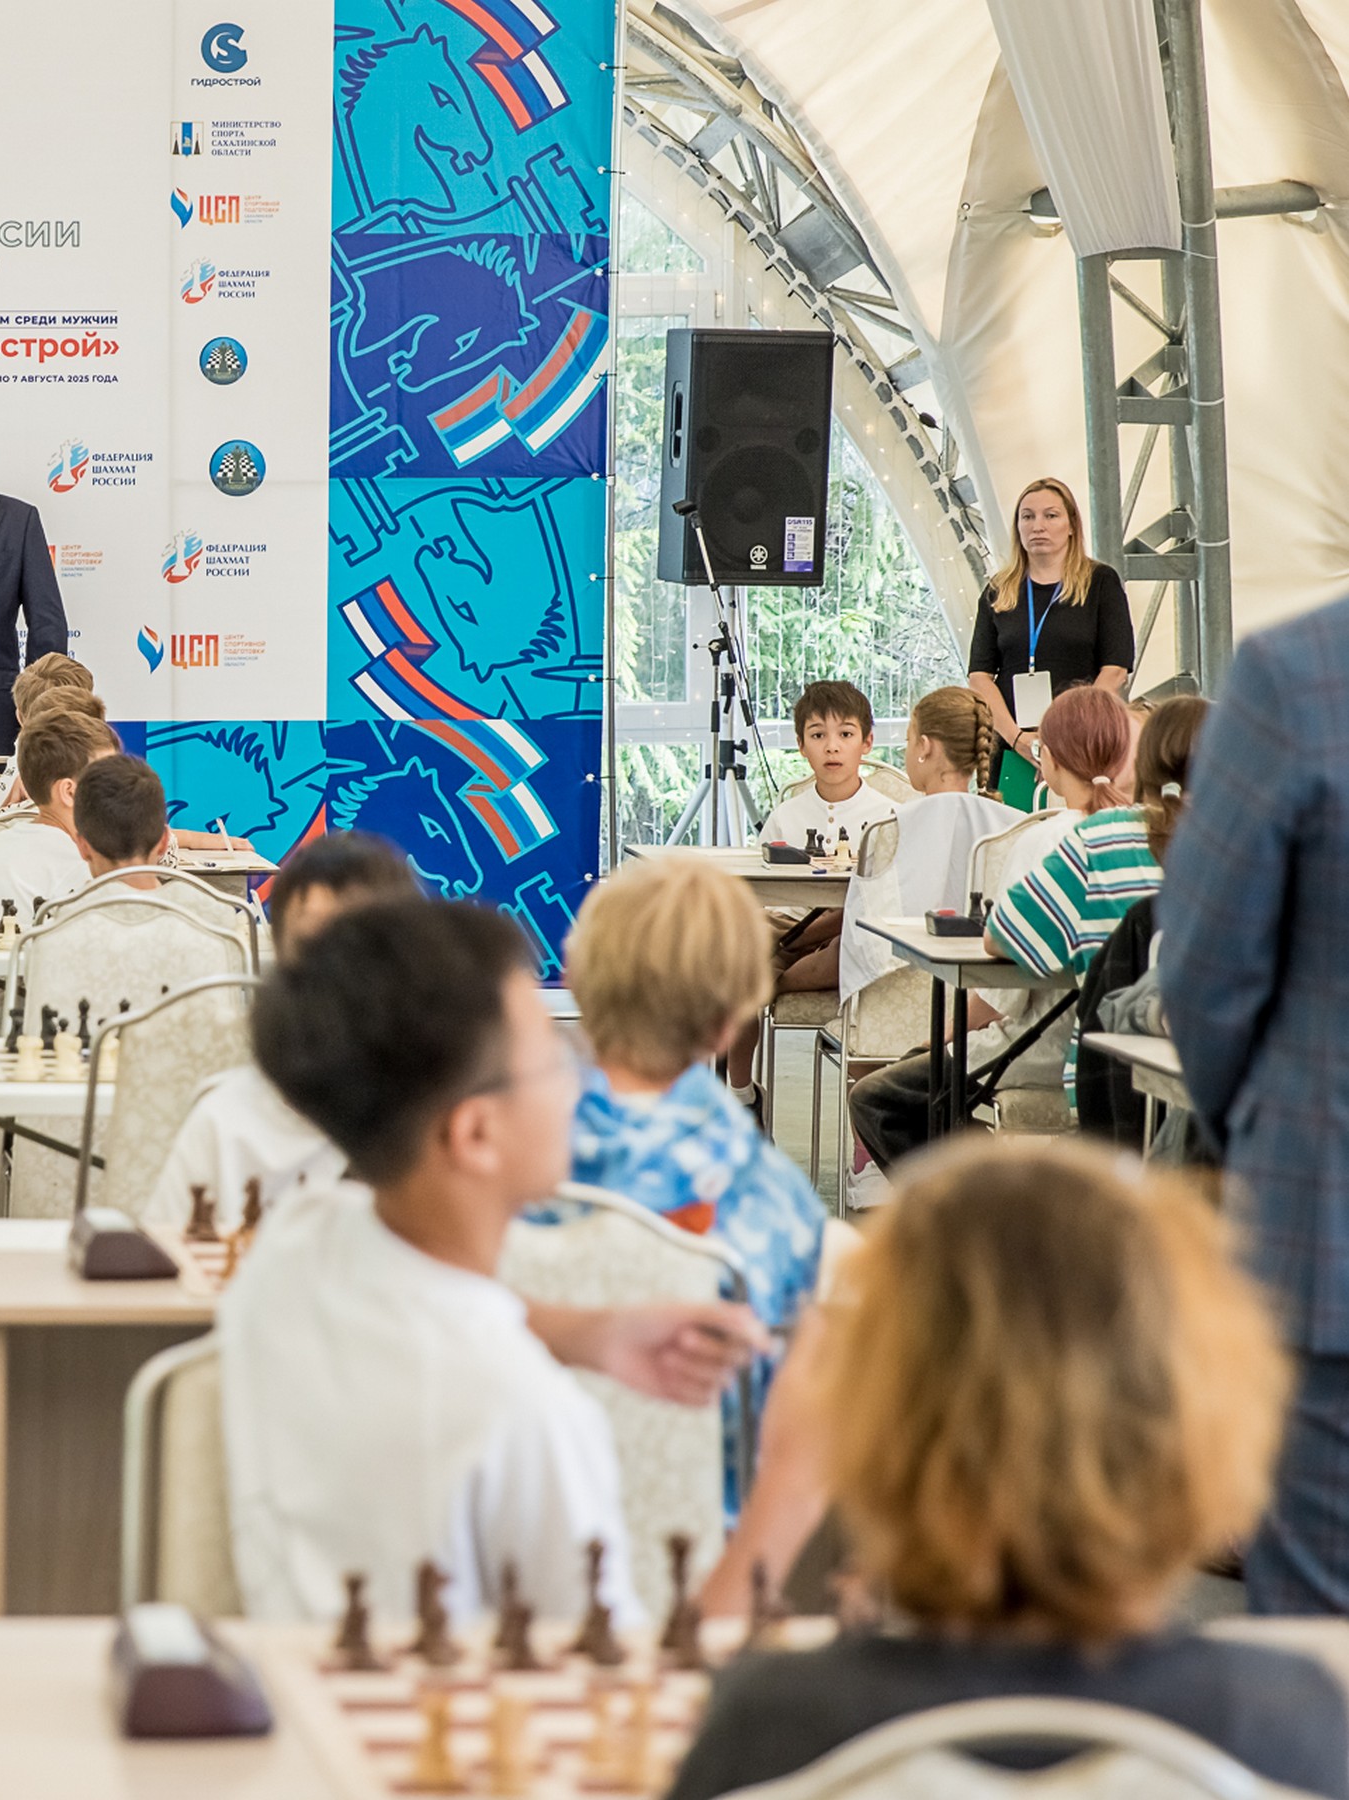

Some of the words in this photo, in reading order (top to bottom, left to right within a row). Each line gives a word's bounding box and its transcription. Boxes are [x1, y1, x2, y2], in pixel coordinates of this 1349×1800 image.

[191, 77, 261, 87] ГИДРОСТРОЙ
[212, 138, 276, 147] САХАЛИНСКОЙ
[212, 149, 252, 157] ОБЛАСТИ
[199, 195, 240, 225] ЦСП
[218, 270, 270, 278] ФЕДЕРАЦИЯ
[15, 315, 57, 326] СРЕДИ
[62, 315, 118, 326] МУЖЧИН
[12, 375, 18, 383] 7
[20, 375, 64, 383] АВГУСТА
[67, 375, 90, 383] 2025
[92, 375, 118, 384] ГОДА
[92, 452, 153, 463] ФЕДЕРАЦИЯ
[92, 465, 136, 474] ШАХМАТ
[92, 477, 136, 486] РОССИИ
[206, 543, 267, 553] ФЕДЕРАЦИЯ
[206, 555, 250, 565] ШАХМАТ
[206, 567, 250, 577] РОССИИ
[171, 634, 219, 670] ЦСП
